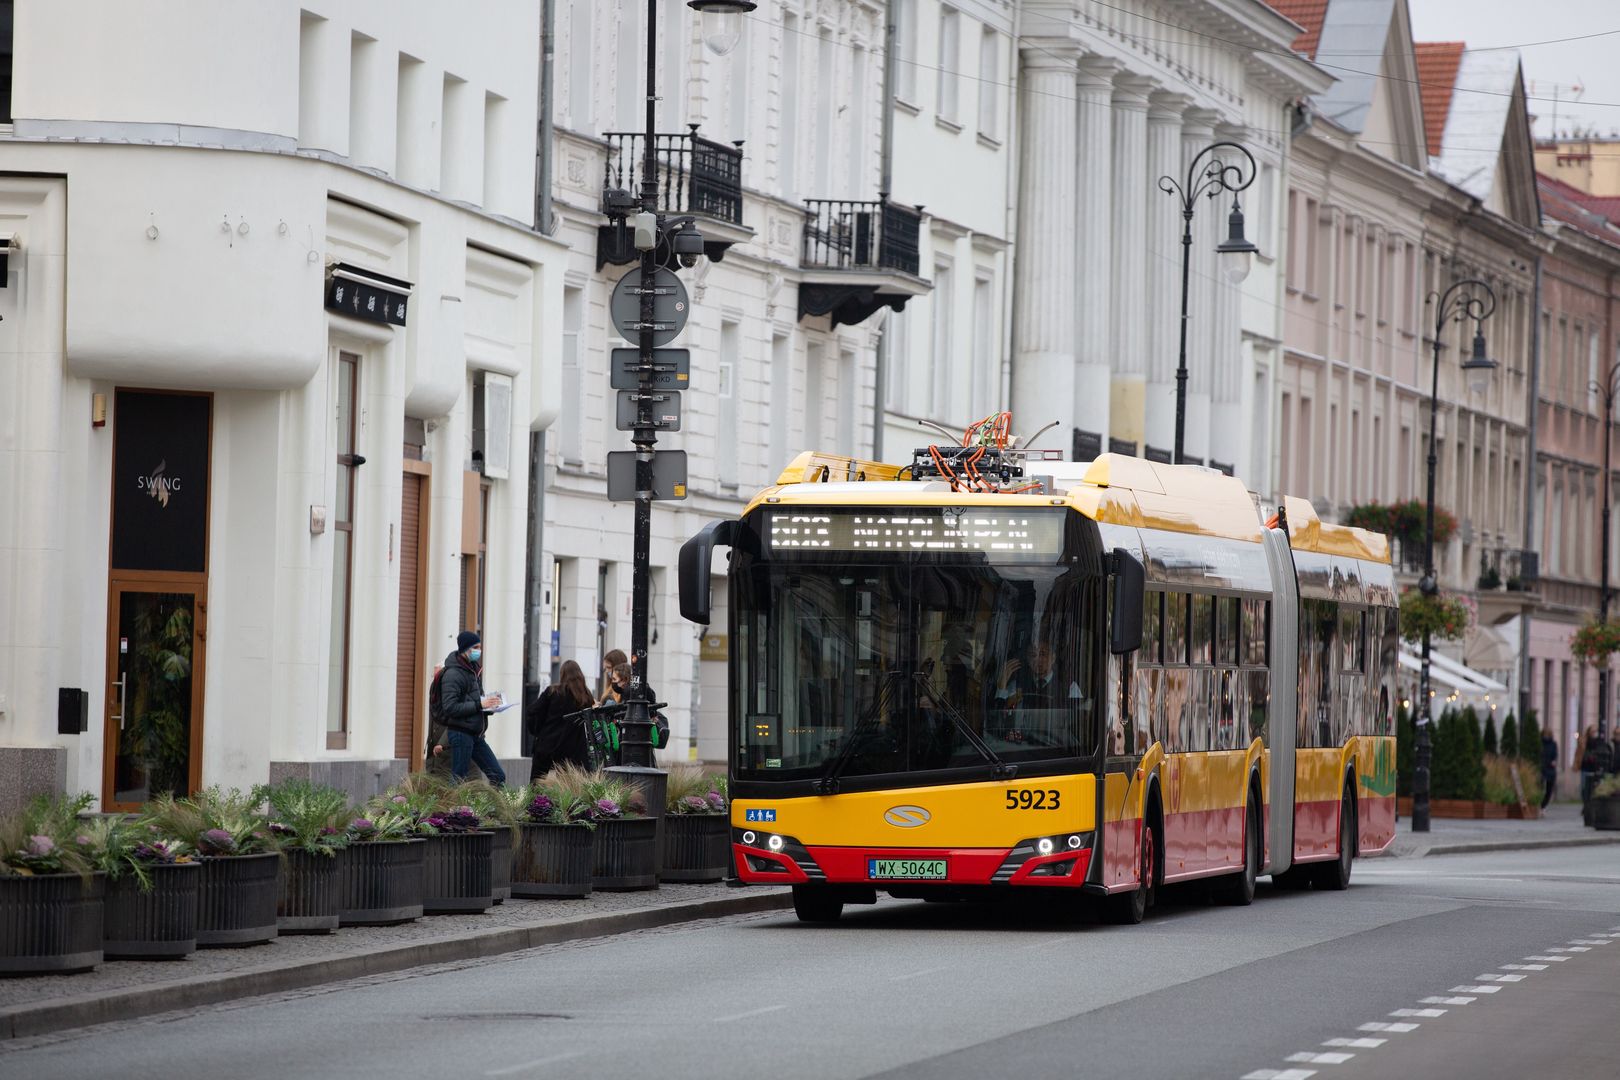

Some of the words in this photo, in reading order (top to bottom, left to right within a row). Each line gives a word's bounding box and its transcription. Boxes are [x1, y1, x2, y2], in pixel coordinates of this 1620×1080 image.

[137, 475, 181, 491] SWING
[1006, 789, 1061, 810] 5923
[878, 861, 896, 875] WX
[901, 861, 943, 876] 5064C
